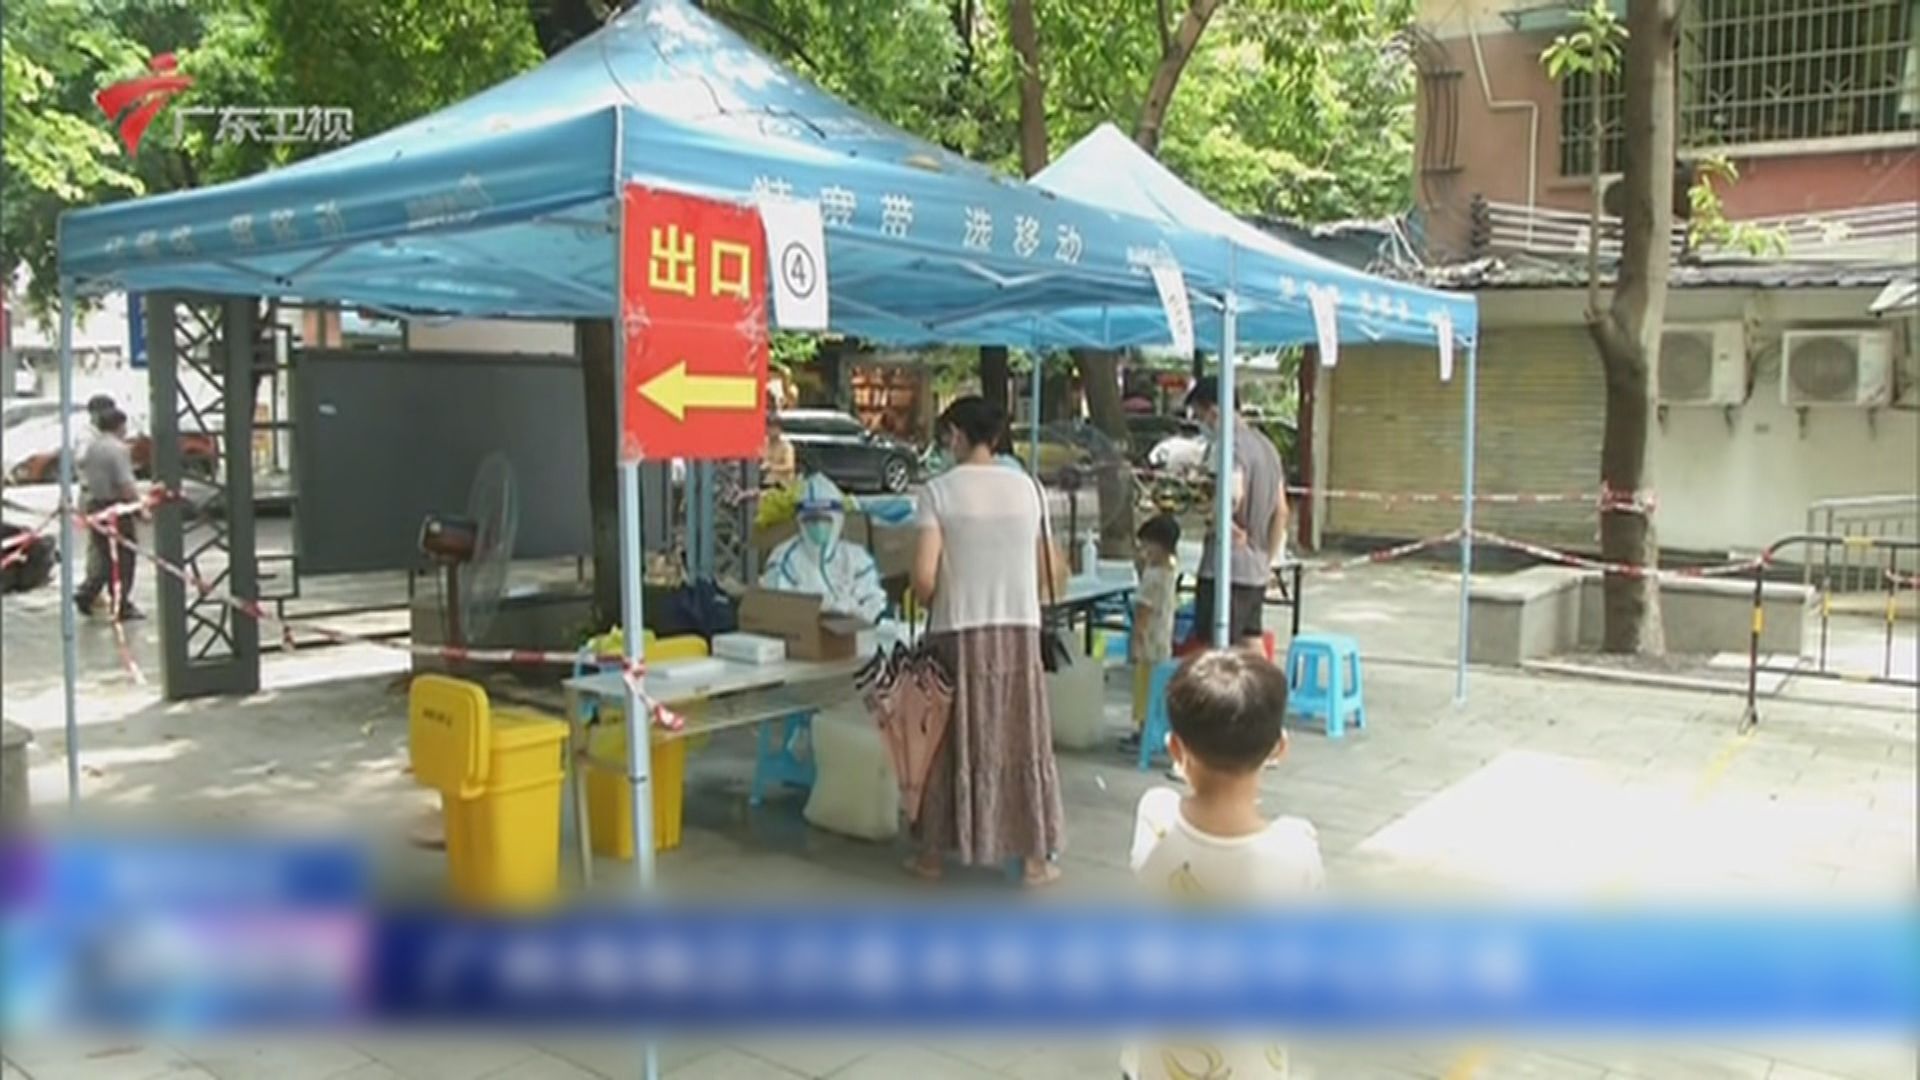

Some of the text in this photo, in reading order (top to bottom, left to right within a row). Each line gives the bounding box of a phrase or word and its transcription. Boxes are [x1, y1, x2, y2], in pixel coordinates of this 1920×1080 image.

[648, 224, 752, 300] 出口
[961, 204, 1083, 266] 选移动
